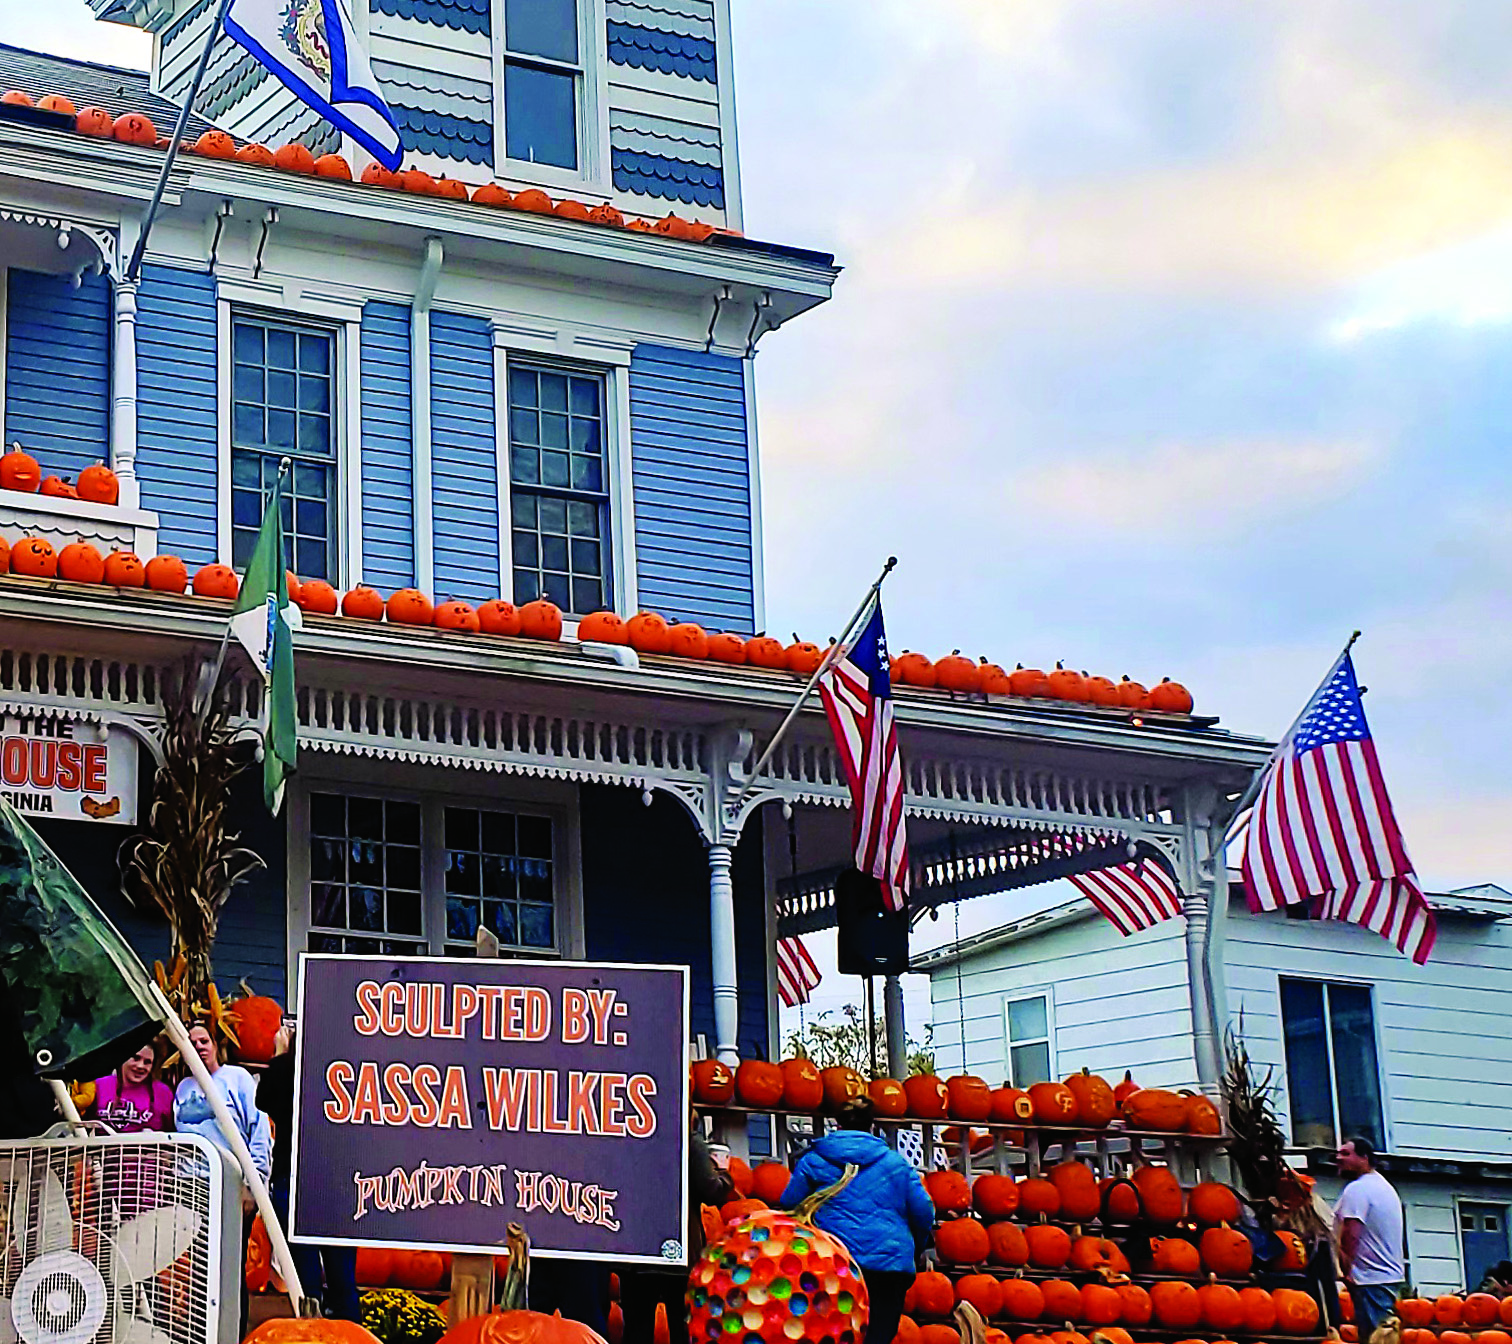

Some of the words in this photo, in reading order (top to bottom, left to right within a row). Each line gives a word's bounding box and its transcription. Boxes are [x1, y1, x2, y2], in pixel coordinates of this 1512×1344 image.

[17, 715, 74, 740] THE
[353, 981, 551, 1043] SCULPTED
[561, 986, 628, 1046] BY:
[323, 1061, 472, 1130] SASSA
[483, 1065, 658, 1139] WILKES
[353, 1160, 507, 1221] PUMPKIN
[514, 1169, 620, 1232] HOUSE
